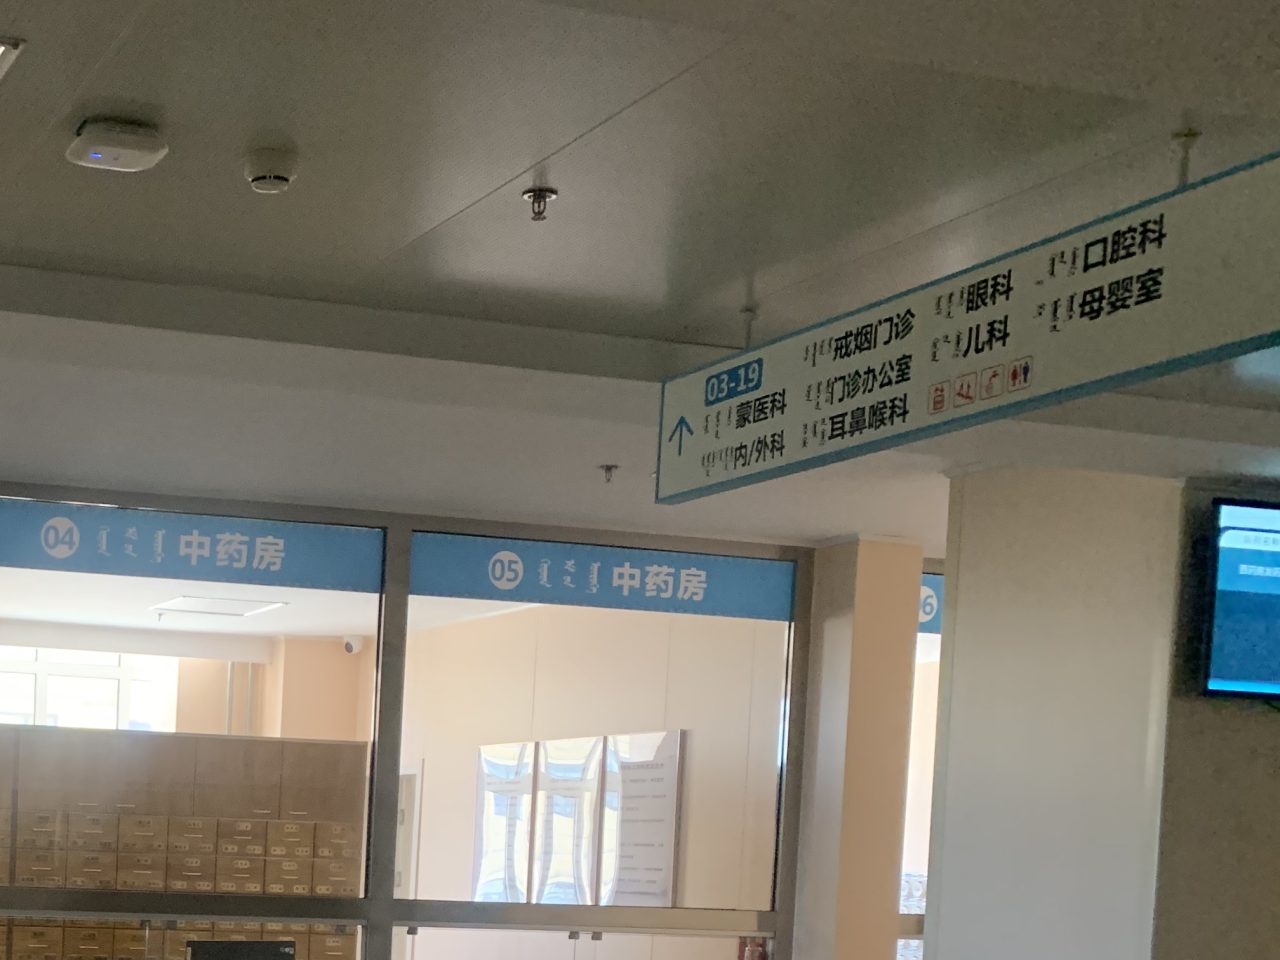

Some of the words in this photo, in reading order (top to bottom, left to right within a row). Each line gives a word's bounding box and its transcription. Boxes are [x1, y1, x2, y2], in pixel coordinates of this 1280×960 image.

[1082, 213, 1167, 273] 口腔科
[965, 269, 1014, 315] 眼科
[1078, 267, 1164, 321] 母婴室
[832, 309, 916, 362] 戒烟门诊
[962, 315, 1010, 359] 儿科
[706, 361, 761, 402] 03-19
[830, 354, 913, 406] 门诊办公室
[734, 389, 787, 430] 蒙医科
[827, 393, 909, 442] 耳鼻喉科
[733, 430, 785, 470] 内/外科
[42, 523, 77, 552] 04
[179, 529, 287, 572] 中药房
[489, 557, 521, 584] 05
[611, 562, 708, 601] 中药房
